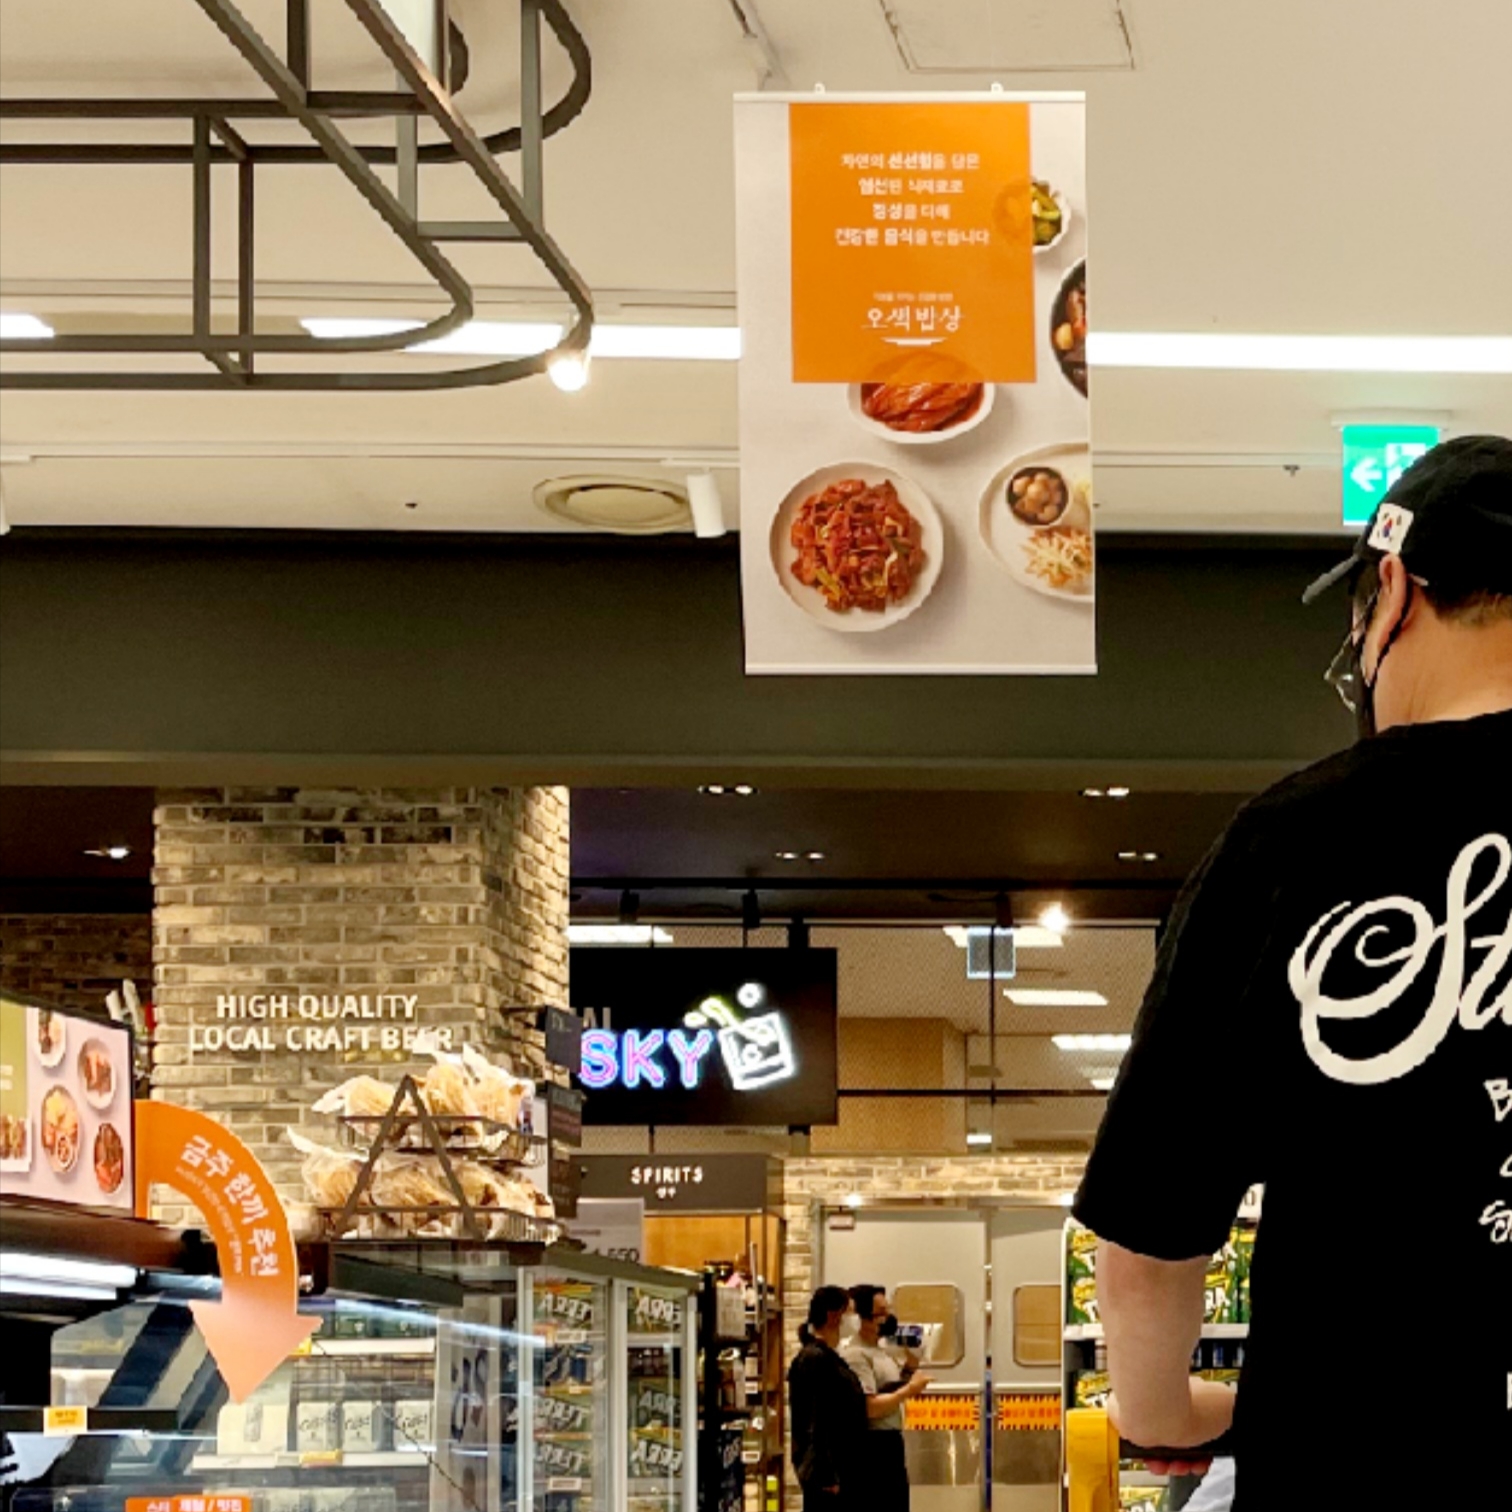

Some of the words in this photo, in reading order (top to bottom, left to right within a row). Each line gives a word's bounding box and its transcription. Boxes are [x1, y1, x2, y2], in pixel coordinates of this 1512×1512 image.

[216, 994, 289, 1019] HIGH
[298, 994, 419, 1021] QUALITY
[188, 1026, 277, 1051] LOCAL
[286, 1026, 371, 1051] CRAFT
[579, 1028, 715, 1090] SKY
[630, 1166, 703, 1184] SPIRITS
[181, 1135, 234, 1177] 금주
[224, 1171, 269, 1225] 한끼
[247, 1228, 280, 1277] 추천
